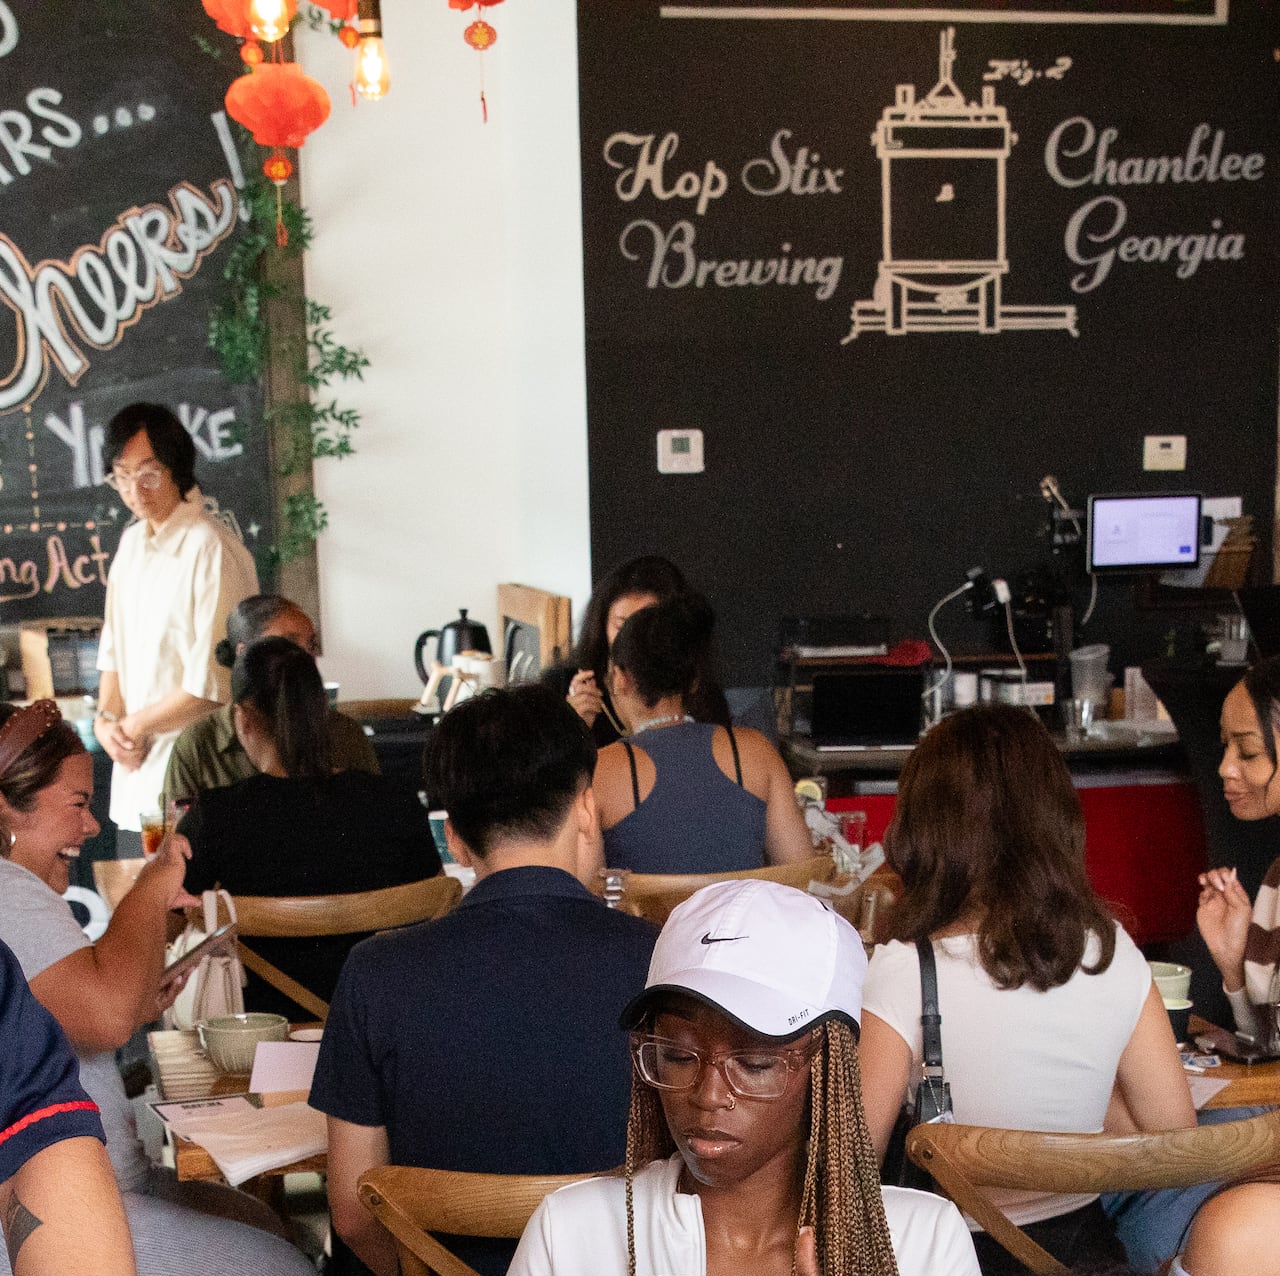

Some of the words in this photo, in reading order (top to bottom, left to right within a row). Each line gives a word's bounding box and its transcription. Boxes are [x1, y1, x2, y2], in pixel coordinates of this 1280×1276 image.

[603, 131, 729, 216] Hop
[741, 128, 844, 197] Stix
[1044, 116, 1266, 188] Chamblee
[619, 218, 844, 300] Brewing
[1064, 195, 1246, 293] Georgia
[44, 535, 110, 593] Act
[787, 1008, 809, 1026] DRI-FIT
